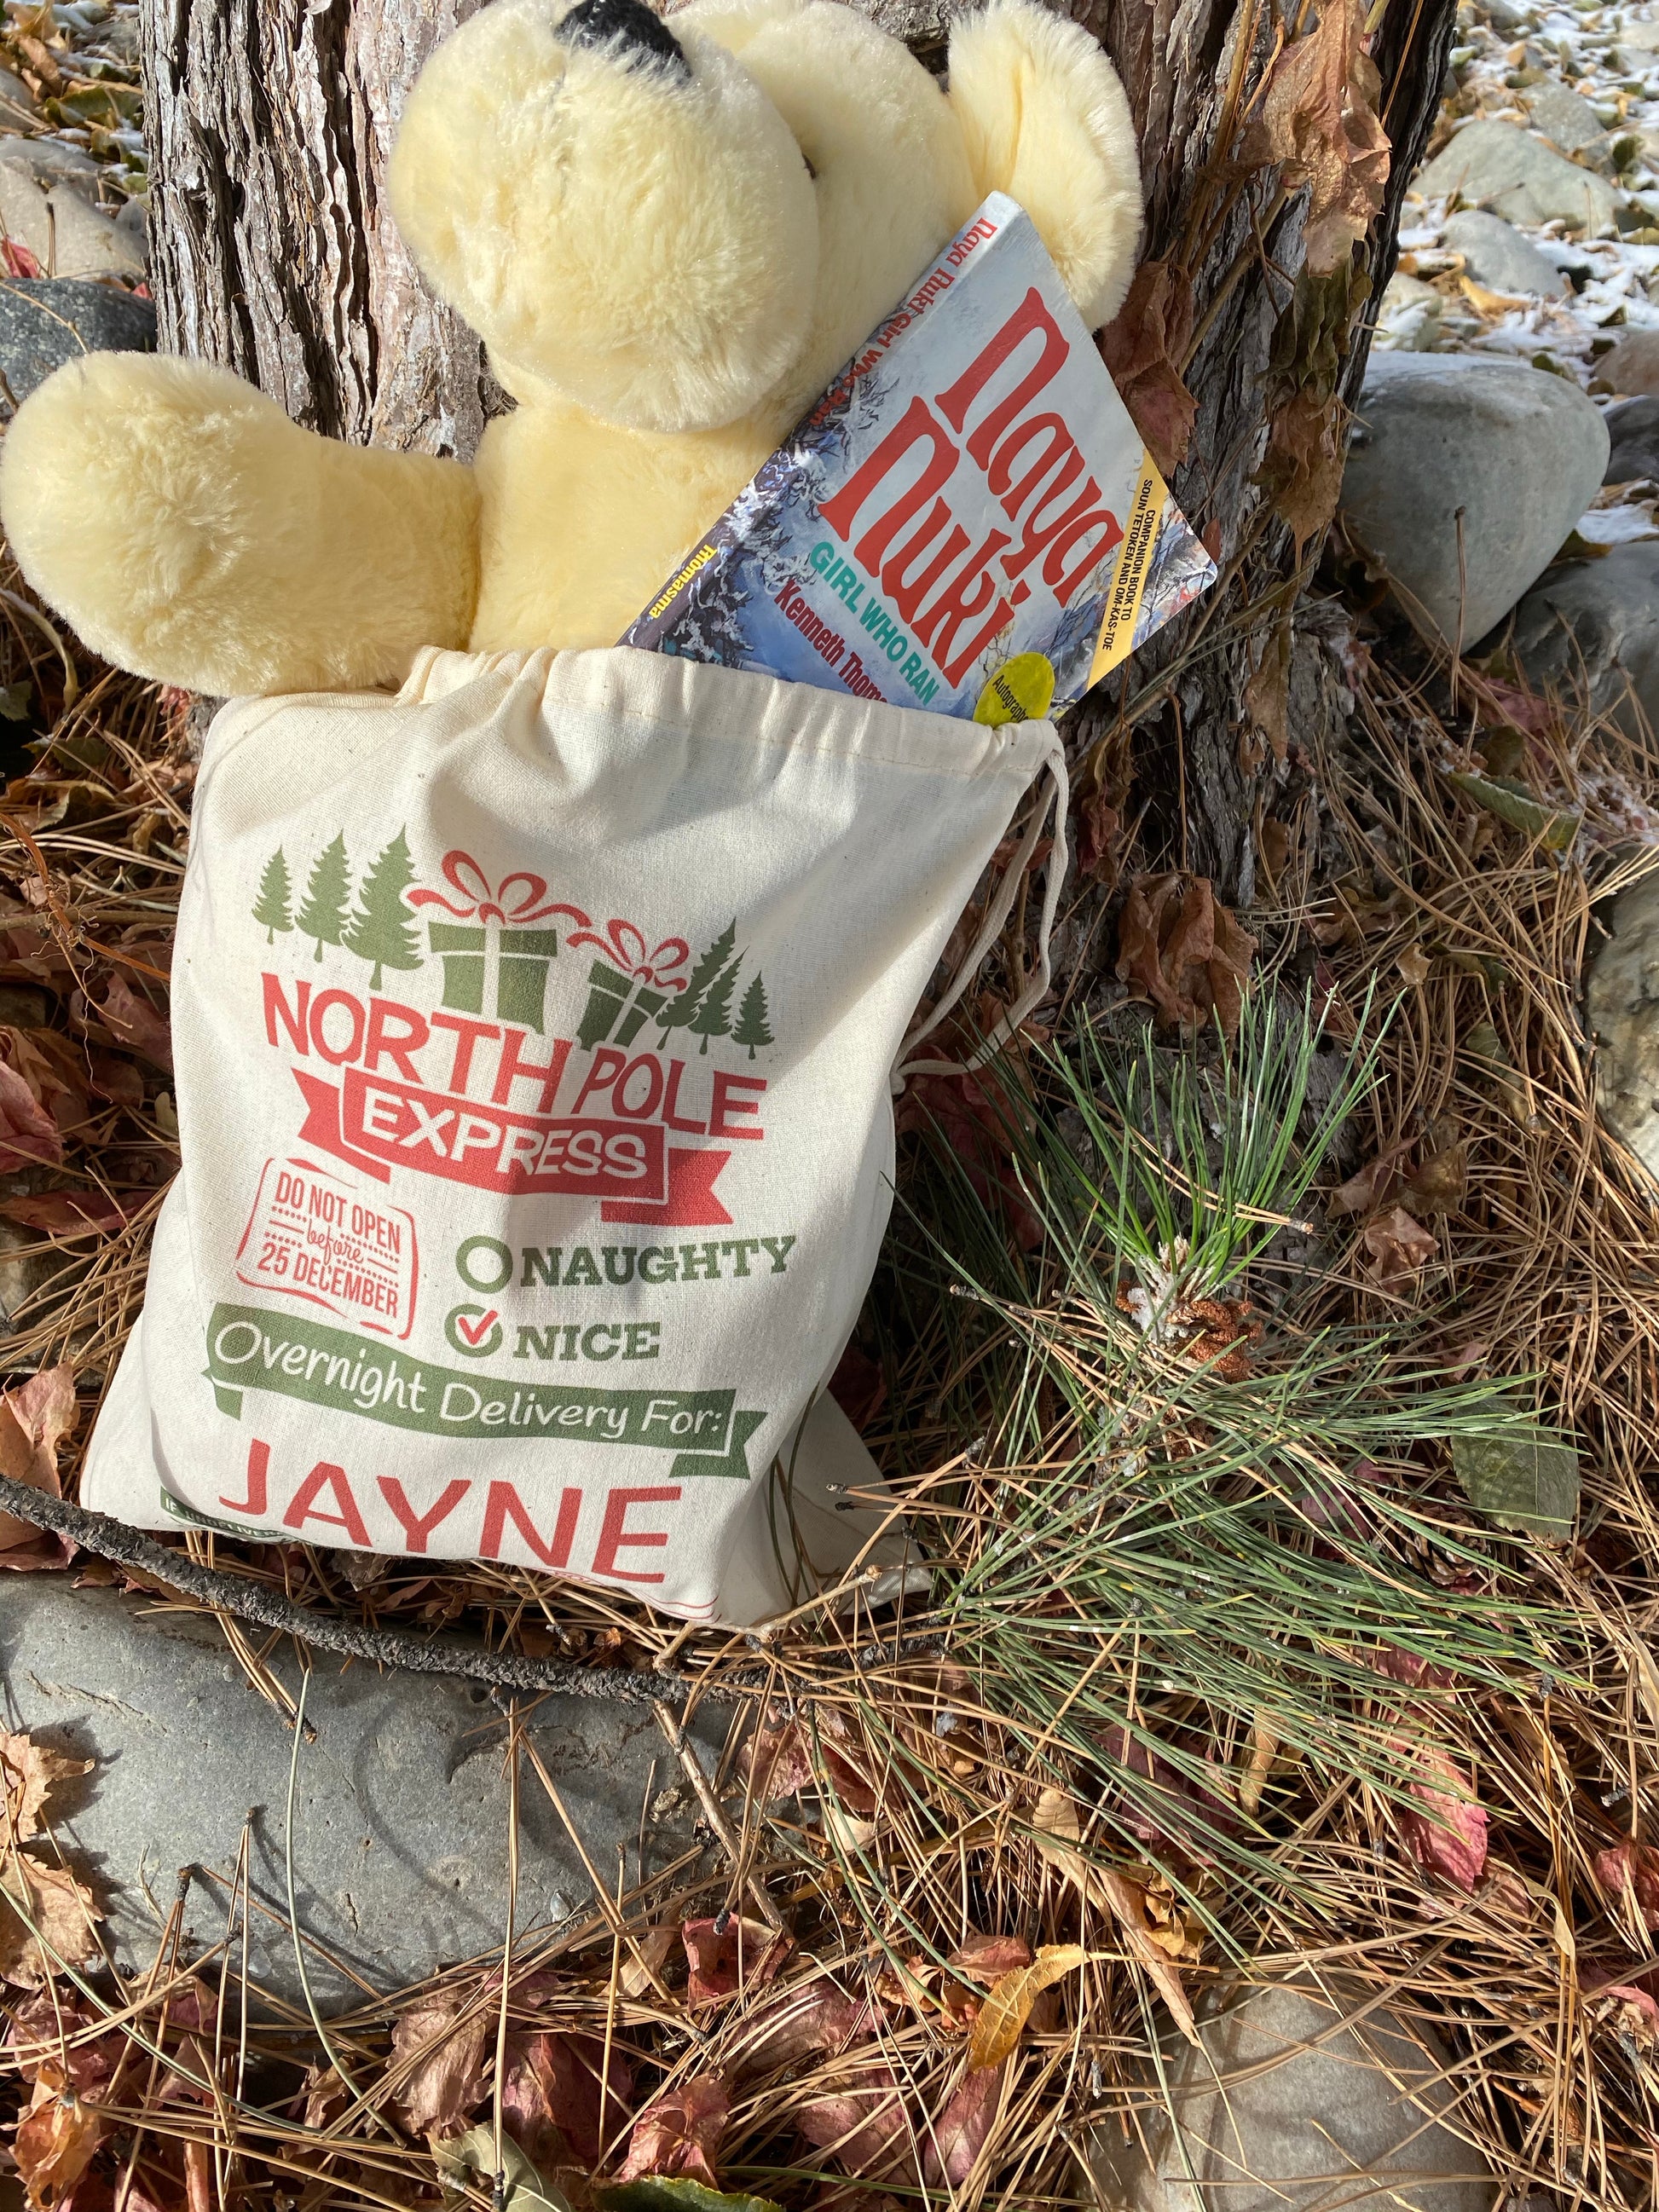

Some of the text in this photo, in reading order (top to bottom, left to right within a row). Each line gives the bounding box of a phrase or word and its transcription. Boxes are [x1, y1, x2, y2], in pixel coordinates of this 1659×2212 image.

[810, 217, 997, 424] Naya Nuki Girl Who Ran
[934, 286, 1124, 608] Naya
[649, 544, 718, 619] Thomasma
[818, 396, 1031, 689] Nuki
[1102, 479, 1153, 650] SOUN TETOKEN AND OM-KAS-TOE
[1121, 510, 1156, 621] COMPANION BOOK TO
[773, 578, 845, 667] Kenneth
[810, 541, 939, 707] GIRL WHO RAN
[260, 972, 767, 1141] NORTH POLE
[361, 1087, 648, 1179] EXPRESS
[275, 1171, 400, 1254] DO NOT OPEN
[307, 1219, 363, 1265] before
[520, 1235, 796, 1287] NAUGHTY
[257, 1242, 398, 1319] 25 DECEMBER
[215, 1321, 723, 1439] Overnight Delivery For:
[512, 1321, 661, 1361] NICE
[218, 1439, 681, 1585] JAYNE
